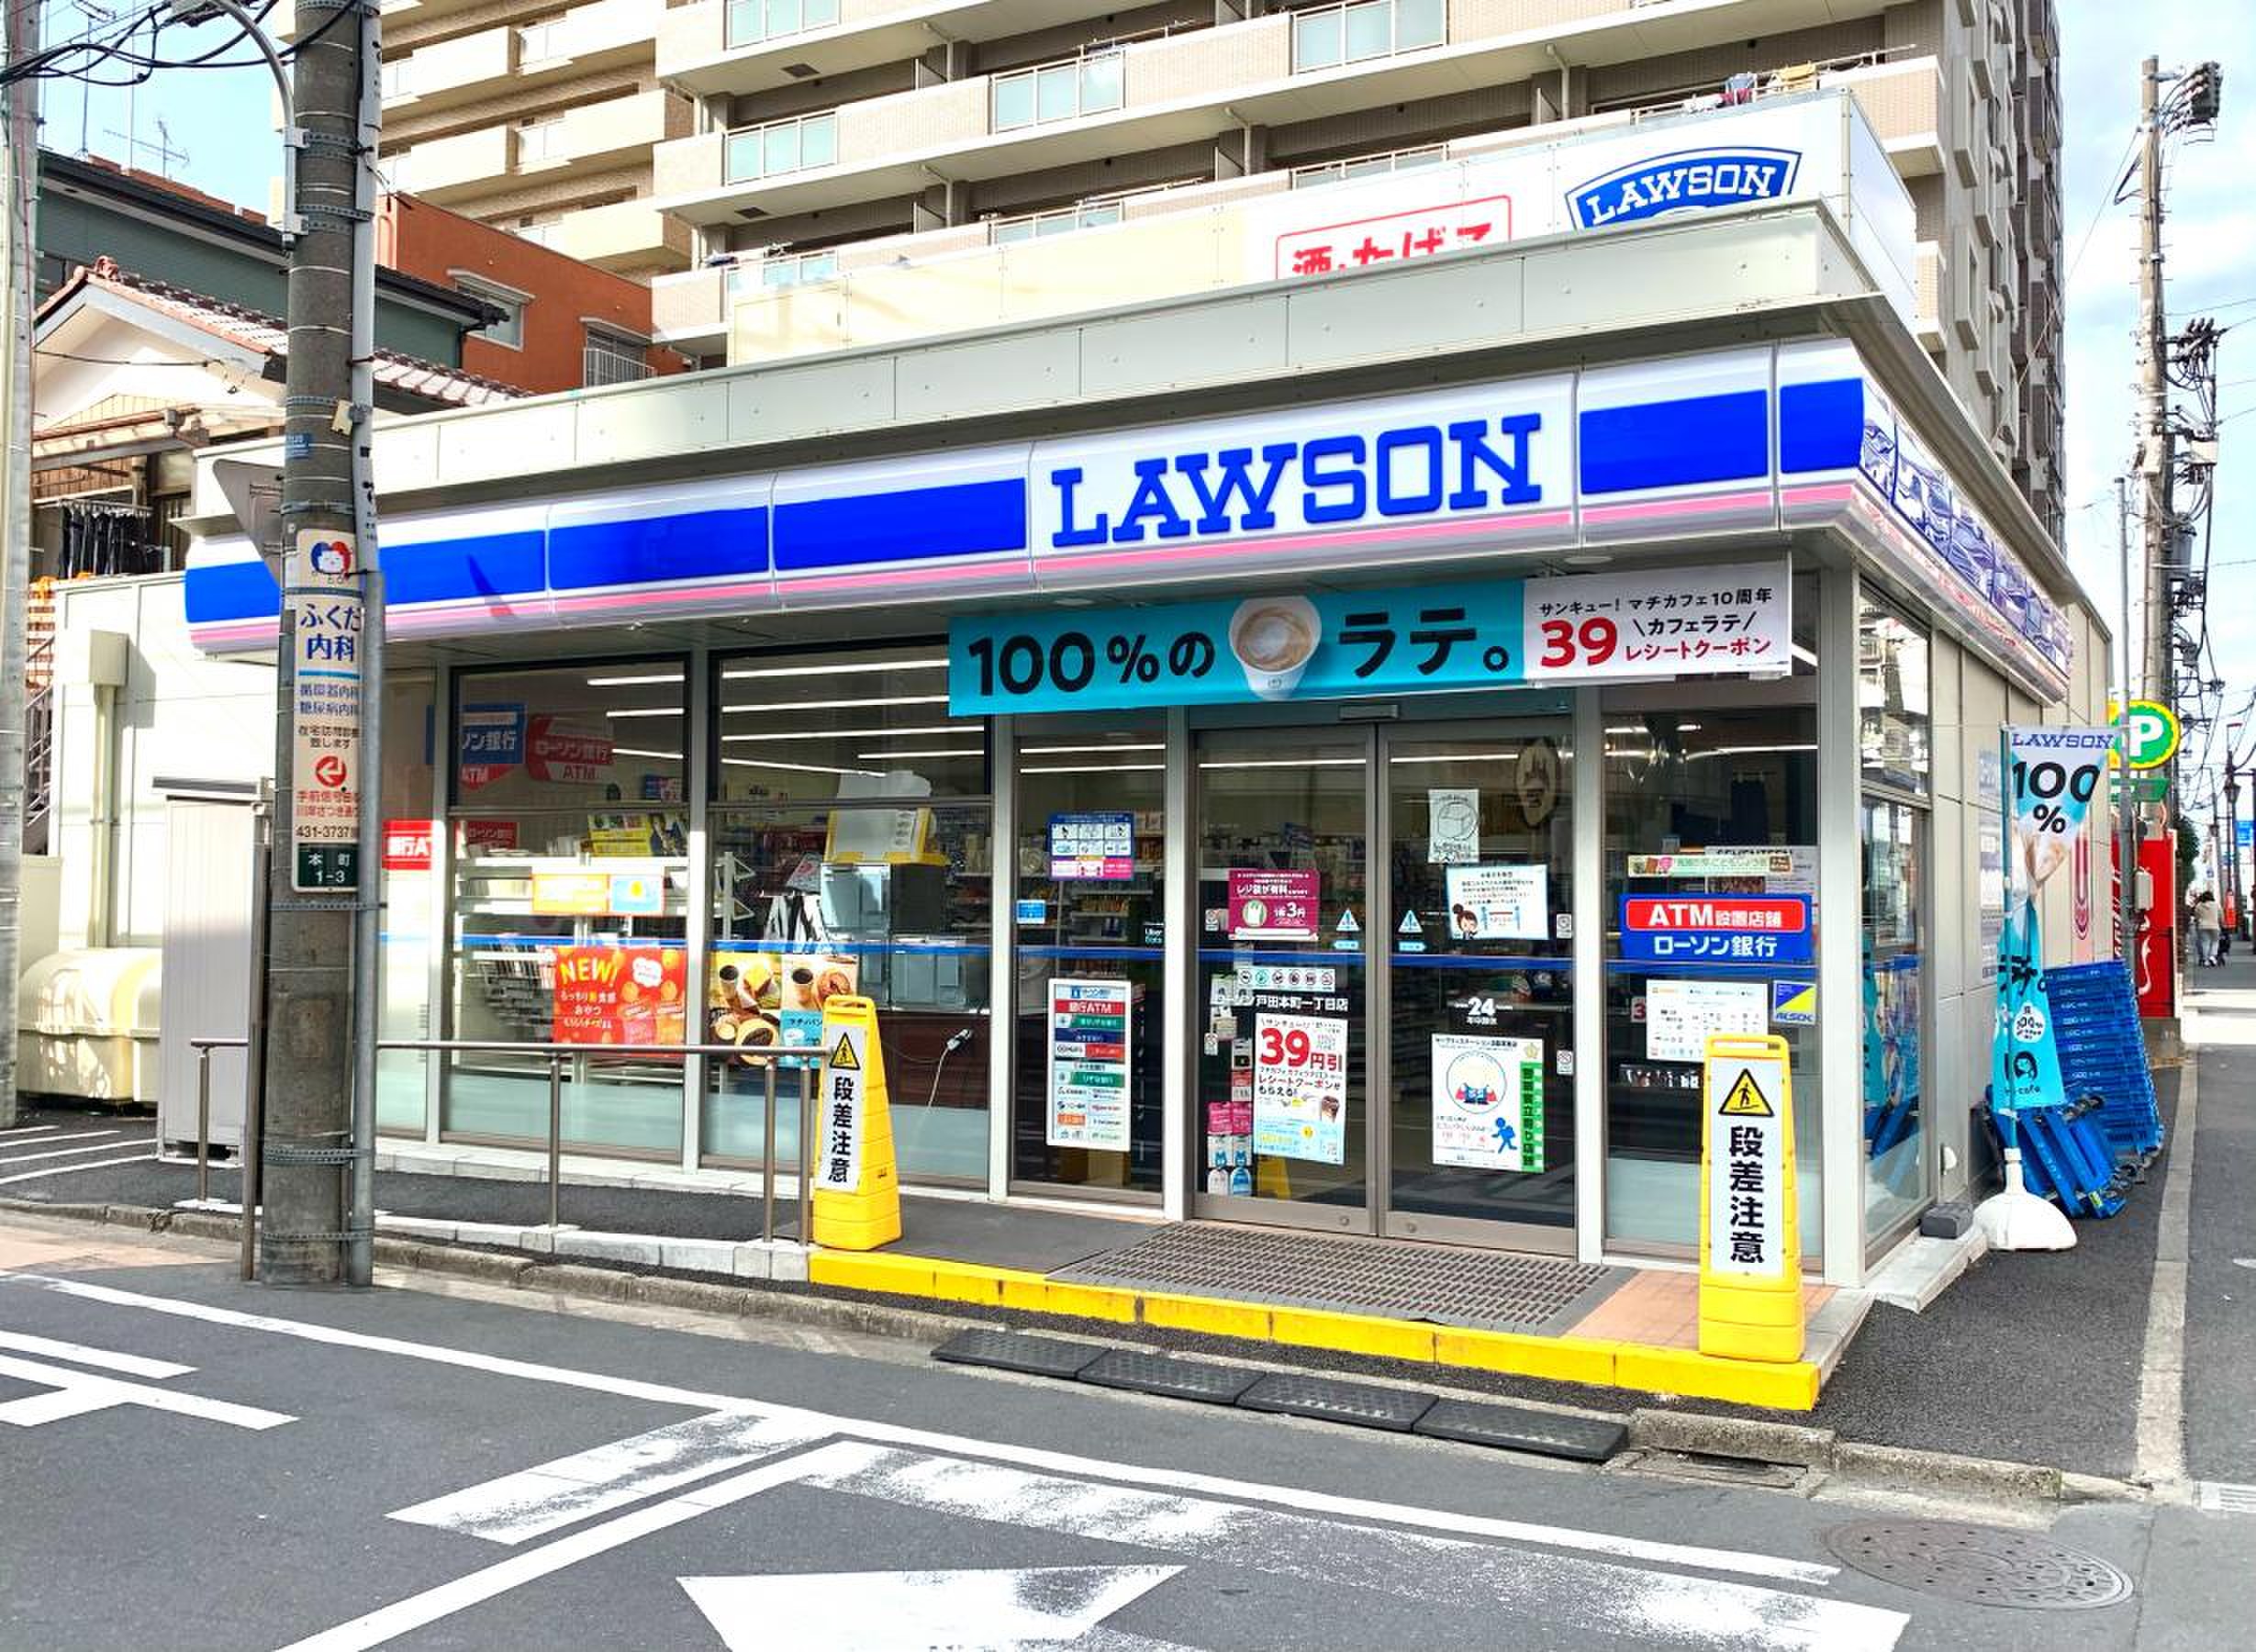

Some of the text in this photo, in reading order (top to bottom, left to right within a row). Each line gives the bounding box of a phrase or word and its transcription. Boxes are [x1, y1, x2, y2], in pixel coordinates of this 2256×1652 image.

[1585, 162, 1777, 226] LAWSON
[1052, 413, 1542, 547] LAWSON
[1628, 587, 1772, 610] マチカフェ10周年
[299, 602, 362, 632] ふくだ
[306, 634, 356, 663] 内科
[1336, 608, 1511, 678] ラテ。
[1540, 616, 1618, 668] 39
[1625, 637, 1771, 662] レシートクーポン
[968, 631, 1215, 697] 100%の
[2011, 733, 2114, 749] LAWSON
[2127, 715, 2164, 757] P
[562, 765, 596, 780] ATM
[2012, 761, 2101, 803] 100
[2032, 803, 2066, 834] %
[315, 869, 346, 885] 1-3
[1647, 903, 1782, 929] ATM設置店舗
[1654, 935, 1778, 958] ローソン銀行
[559, 957, 618, 988] NEW!
[1255, 995, 1348, 1011] 戸田本町一丁目店
[1468, 997, 1496, 1016] 24
[1775, 1012, 1814, 1022] ALSOK
[828, 1076, 854, 1183] 段差注意
[1729, 1125, 1765, 1264] 段差注意
